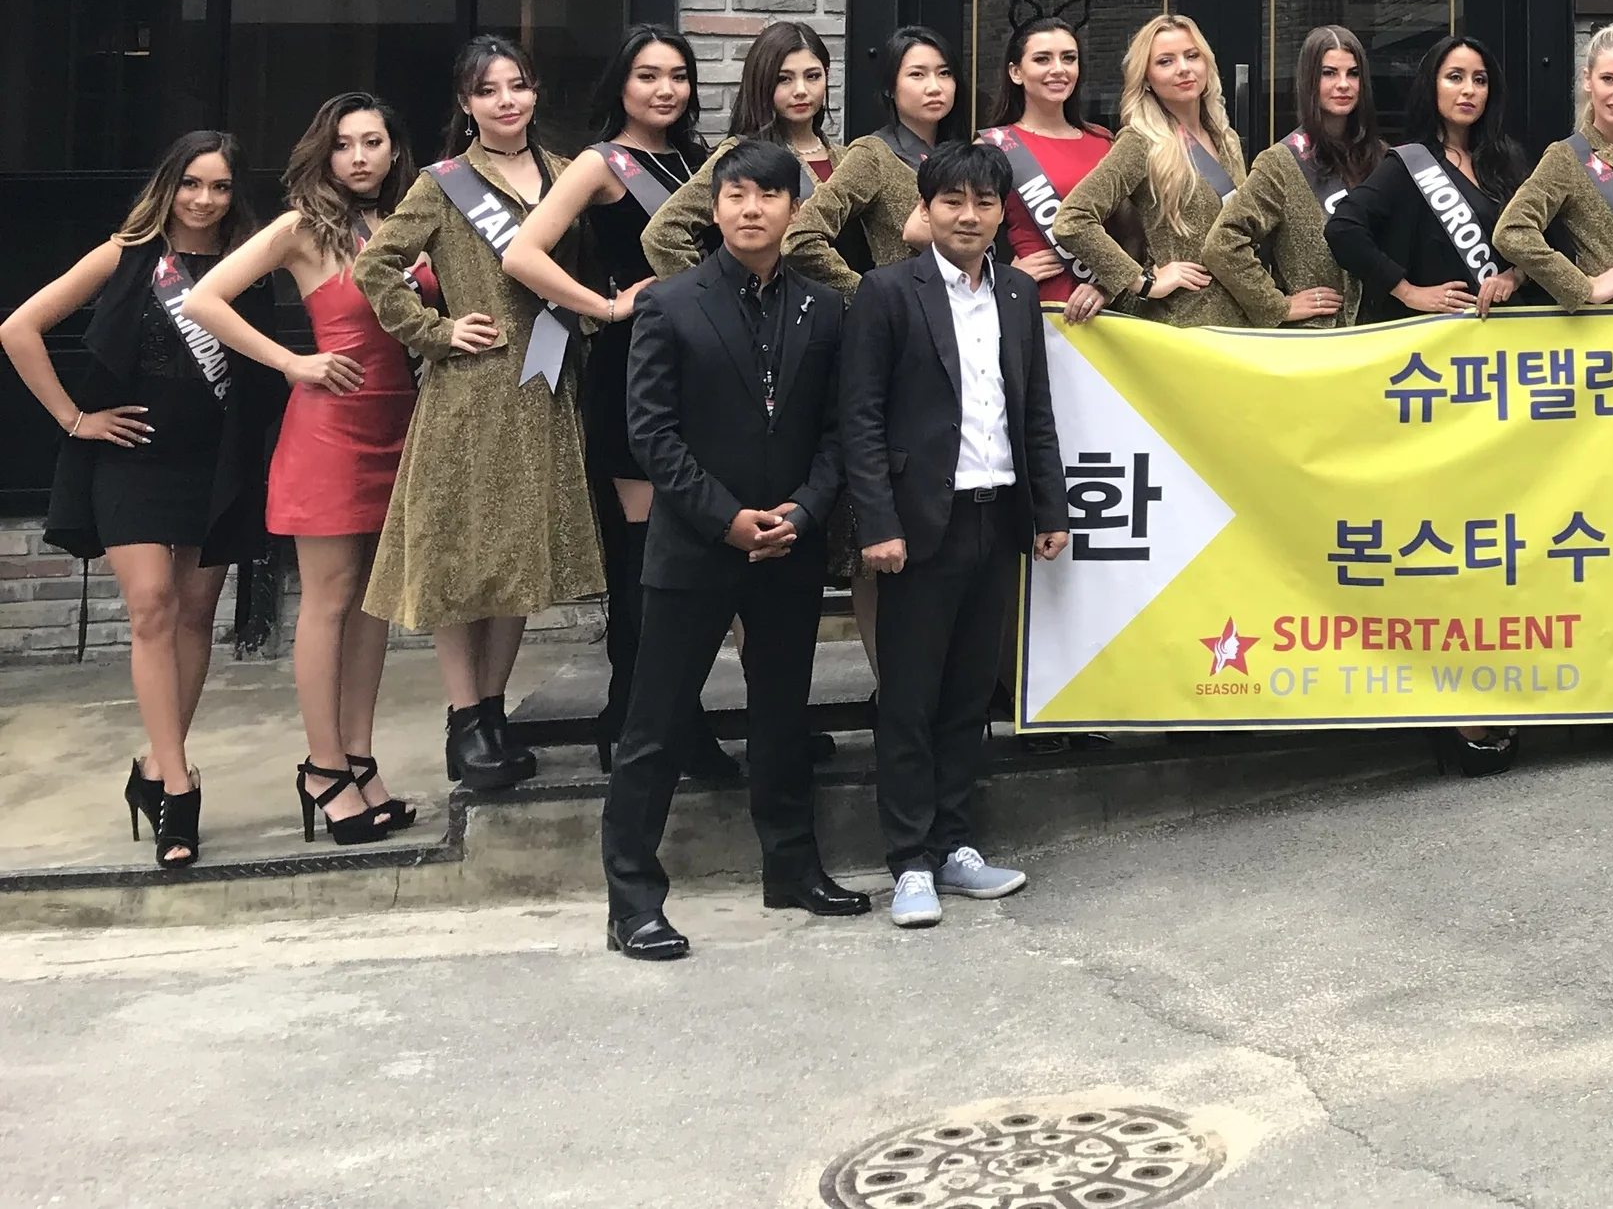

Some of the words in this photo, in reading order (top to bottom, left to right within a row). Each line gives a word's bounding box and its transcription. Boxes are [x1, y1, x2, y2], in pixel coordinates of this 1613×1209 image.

[1064, 452, 1162, 561] 환
[1328, 512, 1526, 587] 본스타
[1273, 614, 1582, 652] SUPERTALENT
[1195, 683, 1249, 696] SEASON
[1253, 683, 1261, 695] 9
[1269, 667, 1320, 696] OF
[1338, 665, 1413, 694] THE
[1431, 663, 1580, 694] WORLD
